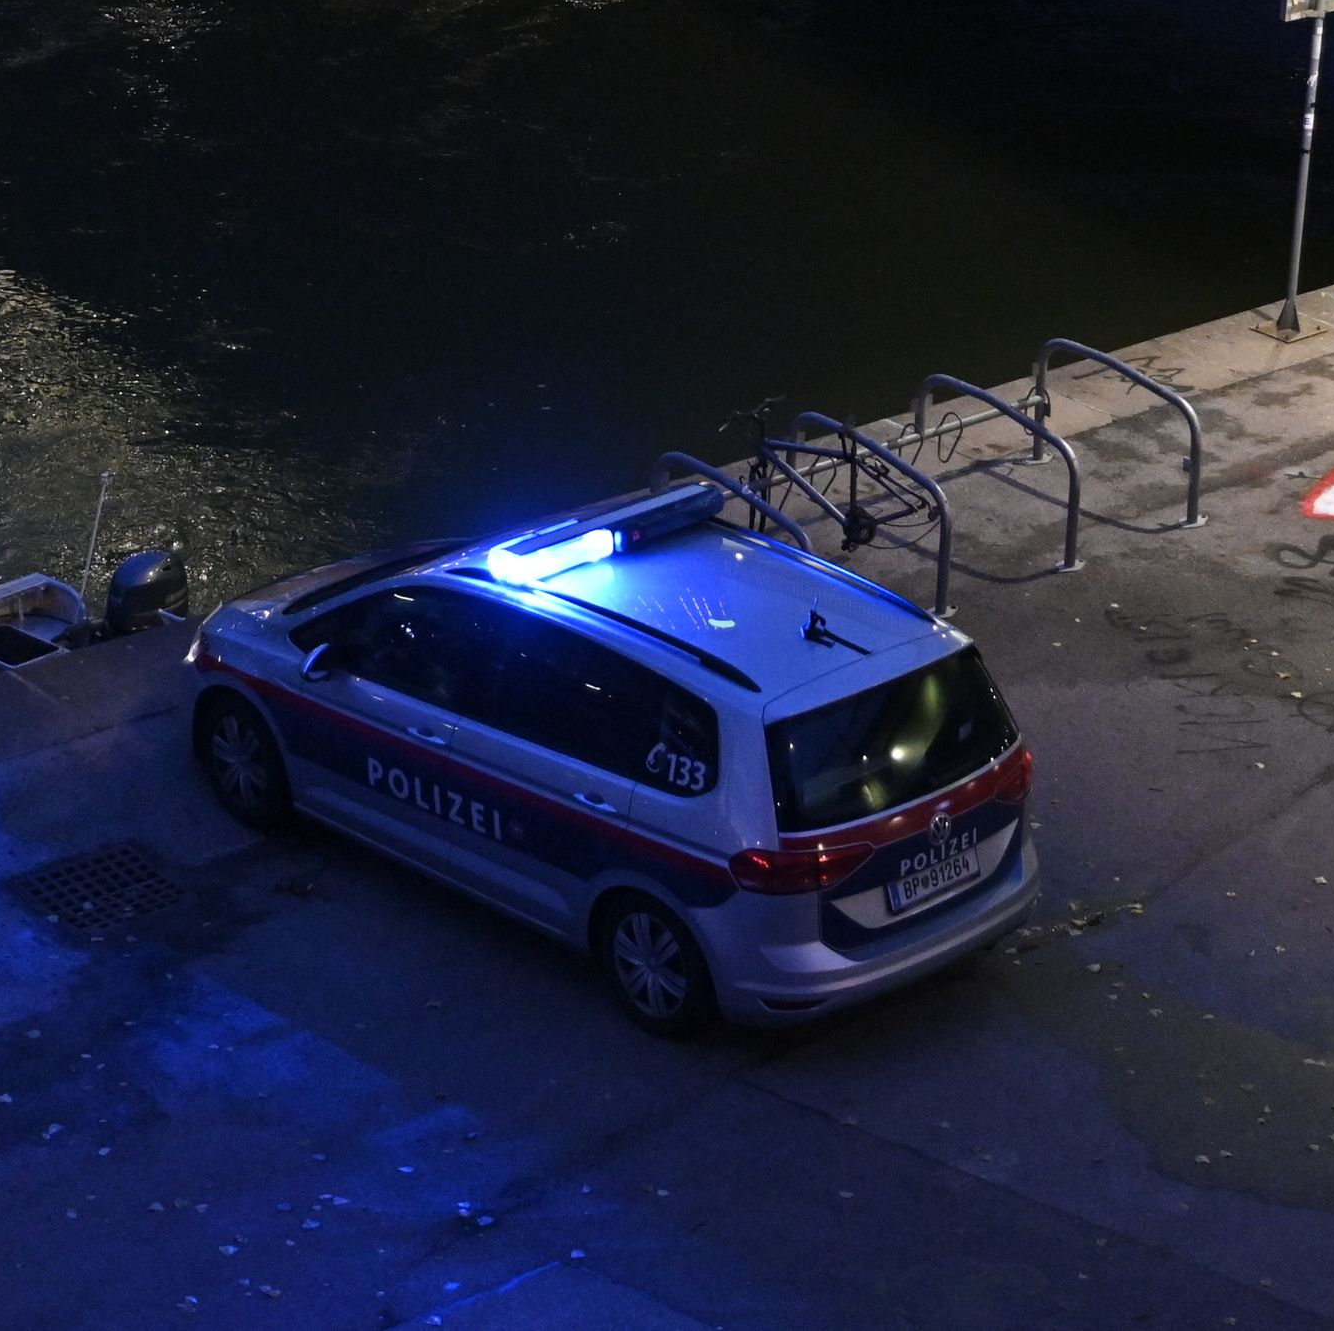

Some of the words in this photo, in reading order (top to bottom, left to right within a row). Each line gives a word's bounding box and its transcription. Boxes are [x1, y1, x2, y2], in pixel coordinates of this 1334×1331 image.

[668, 753, 706, 790] 133
[367, 757, 501, 841] POLIZEI
[900, 827, 977, 876] POLIZEI
[903, 874, 920, 900] BP
[929, 854, 970, 887] 91264
